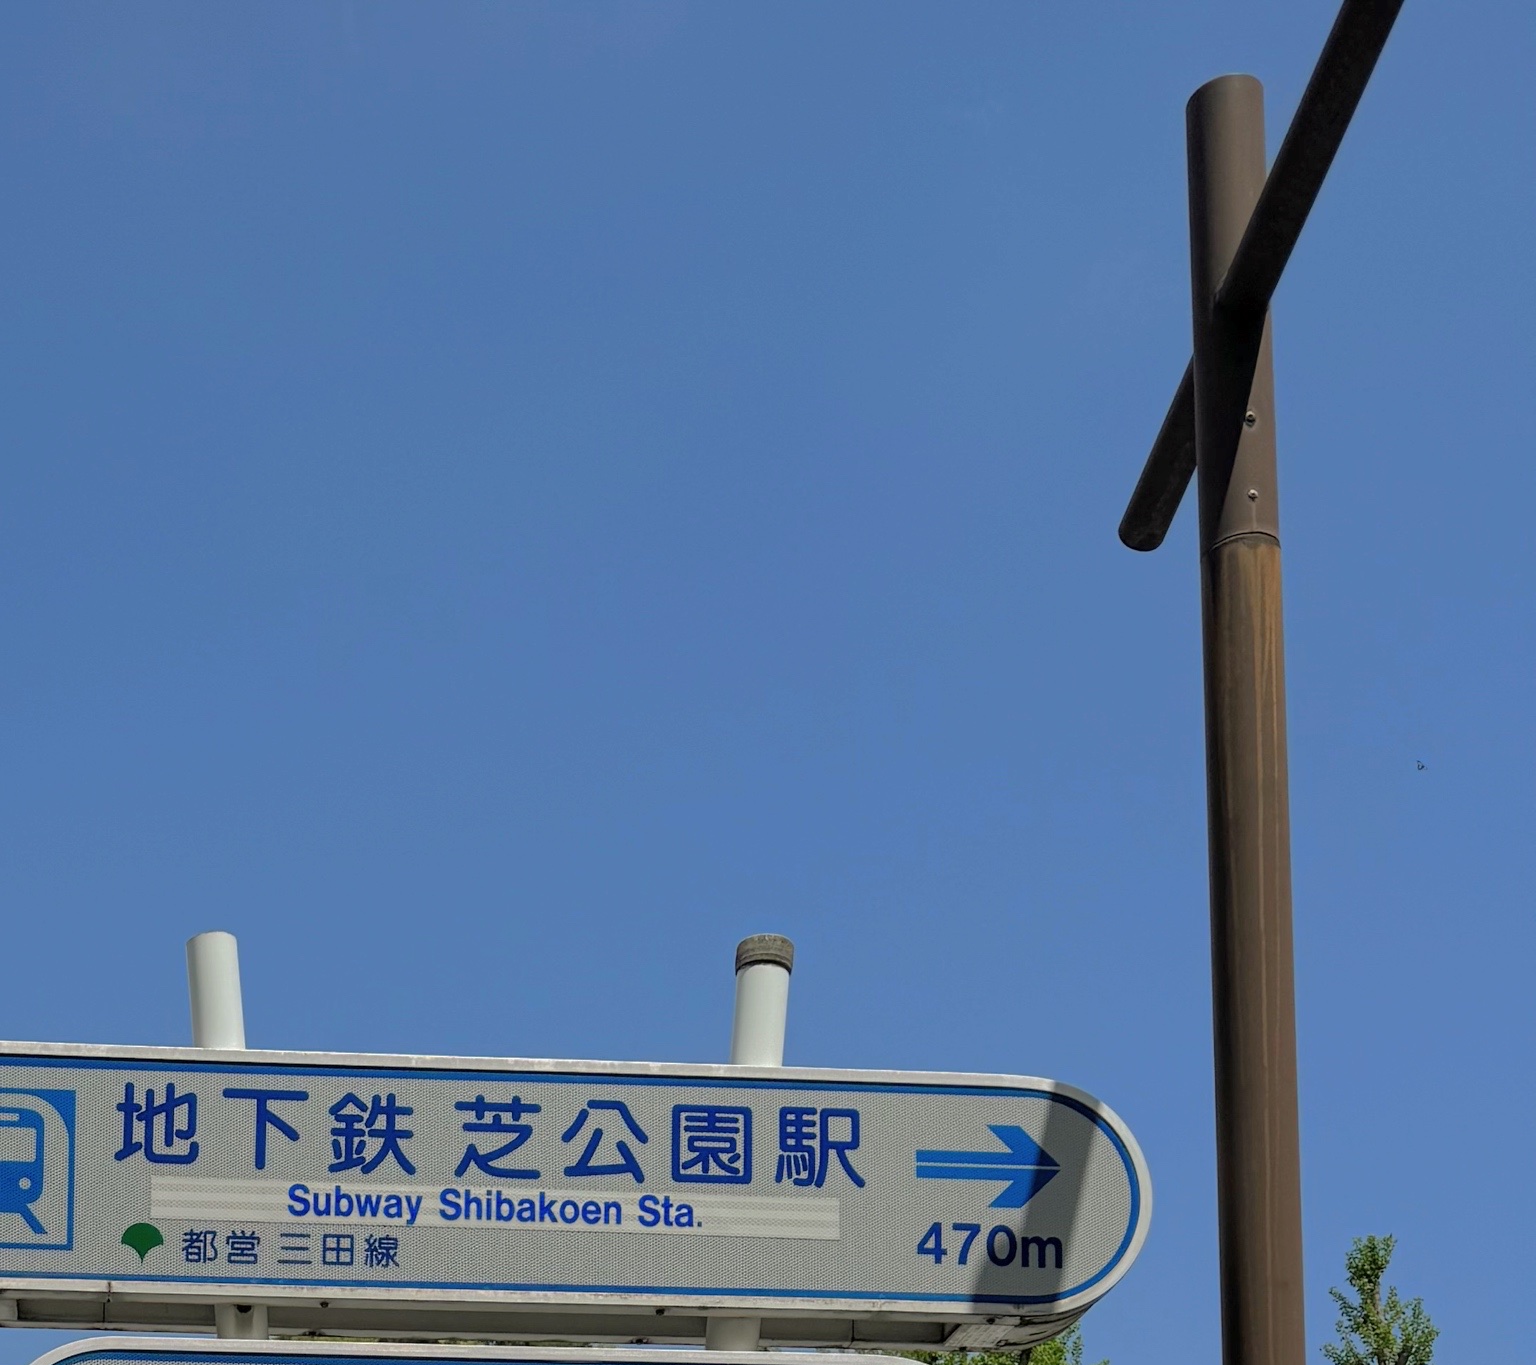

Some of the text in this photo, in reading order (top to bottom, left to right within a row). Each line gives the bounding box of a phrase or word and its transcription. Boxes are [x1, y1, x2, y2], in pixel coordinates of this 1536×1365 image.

[114, 1081, 865, 1188] 地下鉄芝公園駅
[287, 1183, 704, 1229] Subway Shibakoen Sta.
[917, 1222, 1064, 1269] 470m
